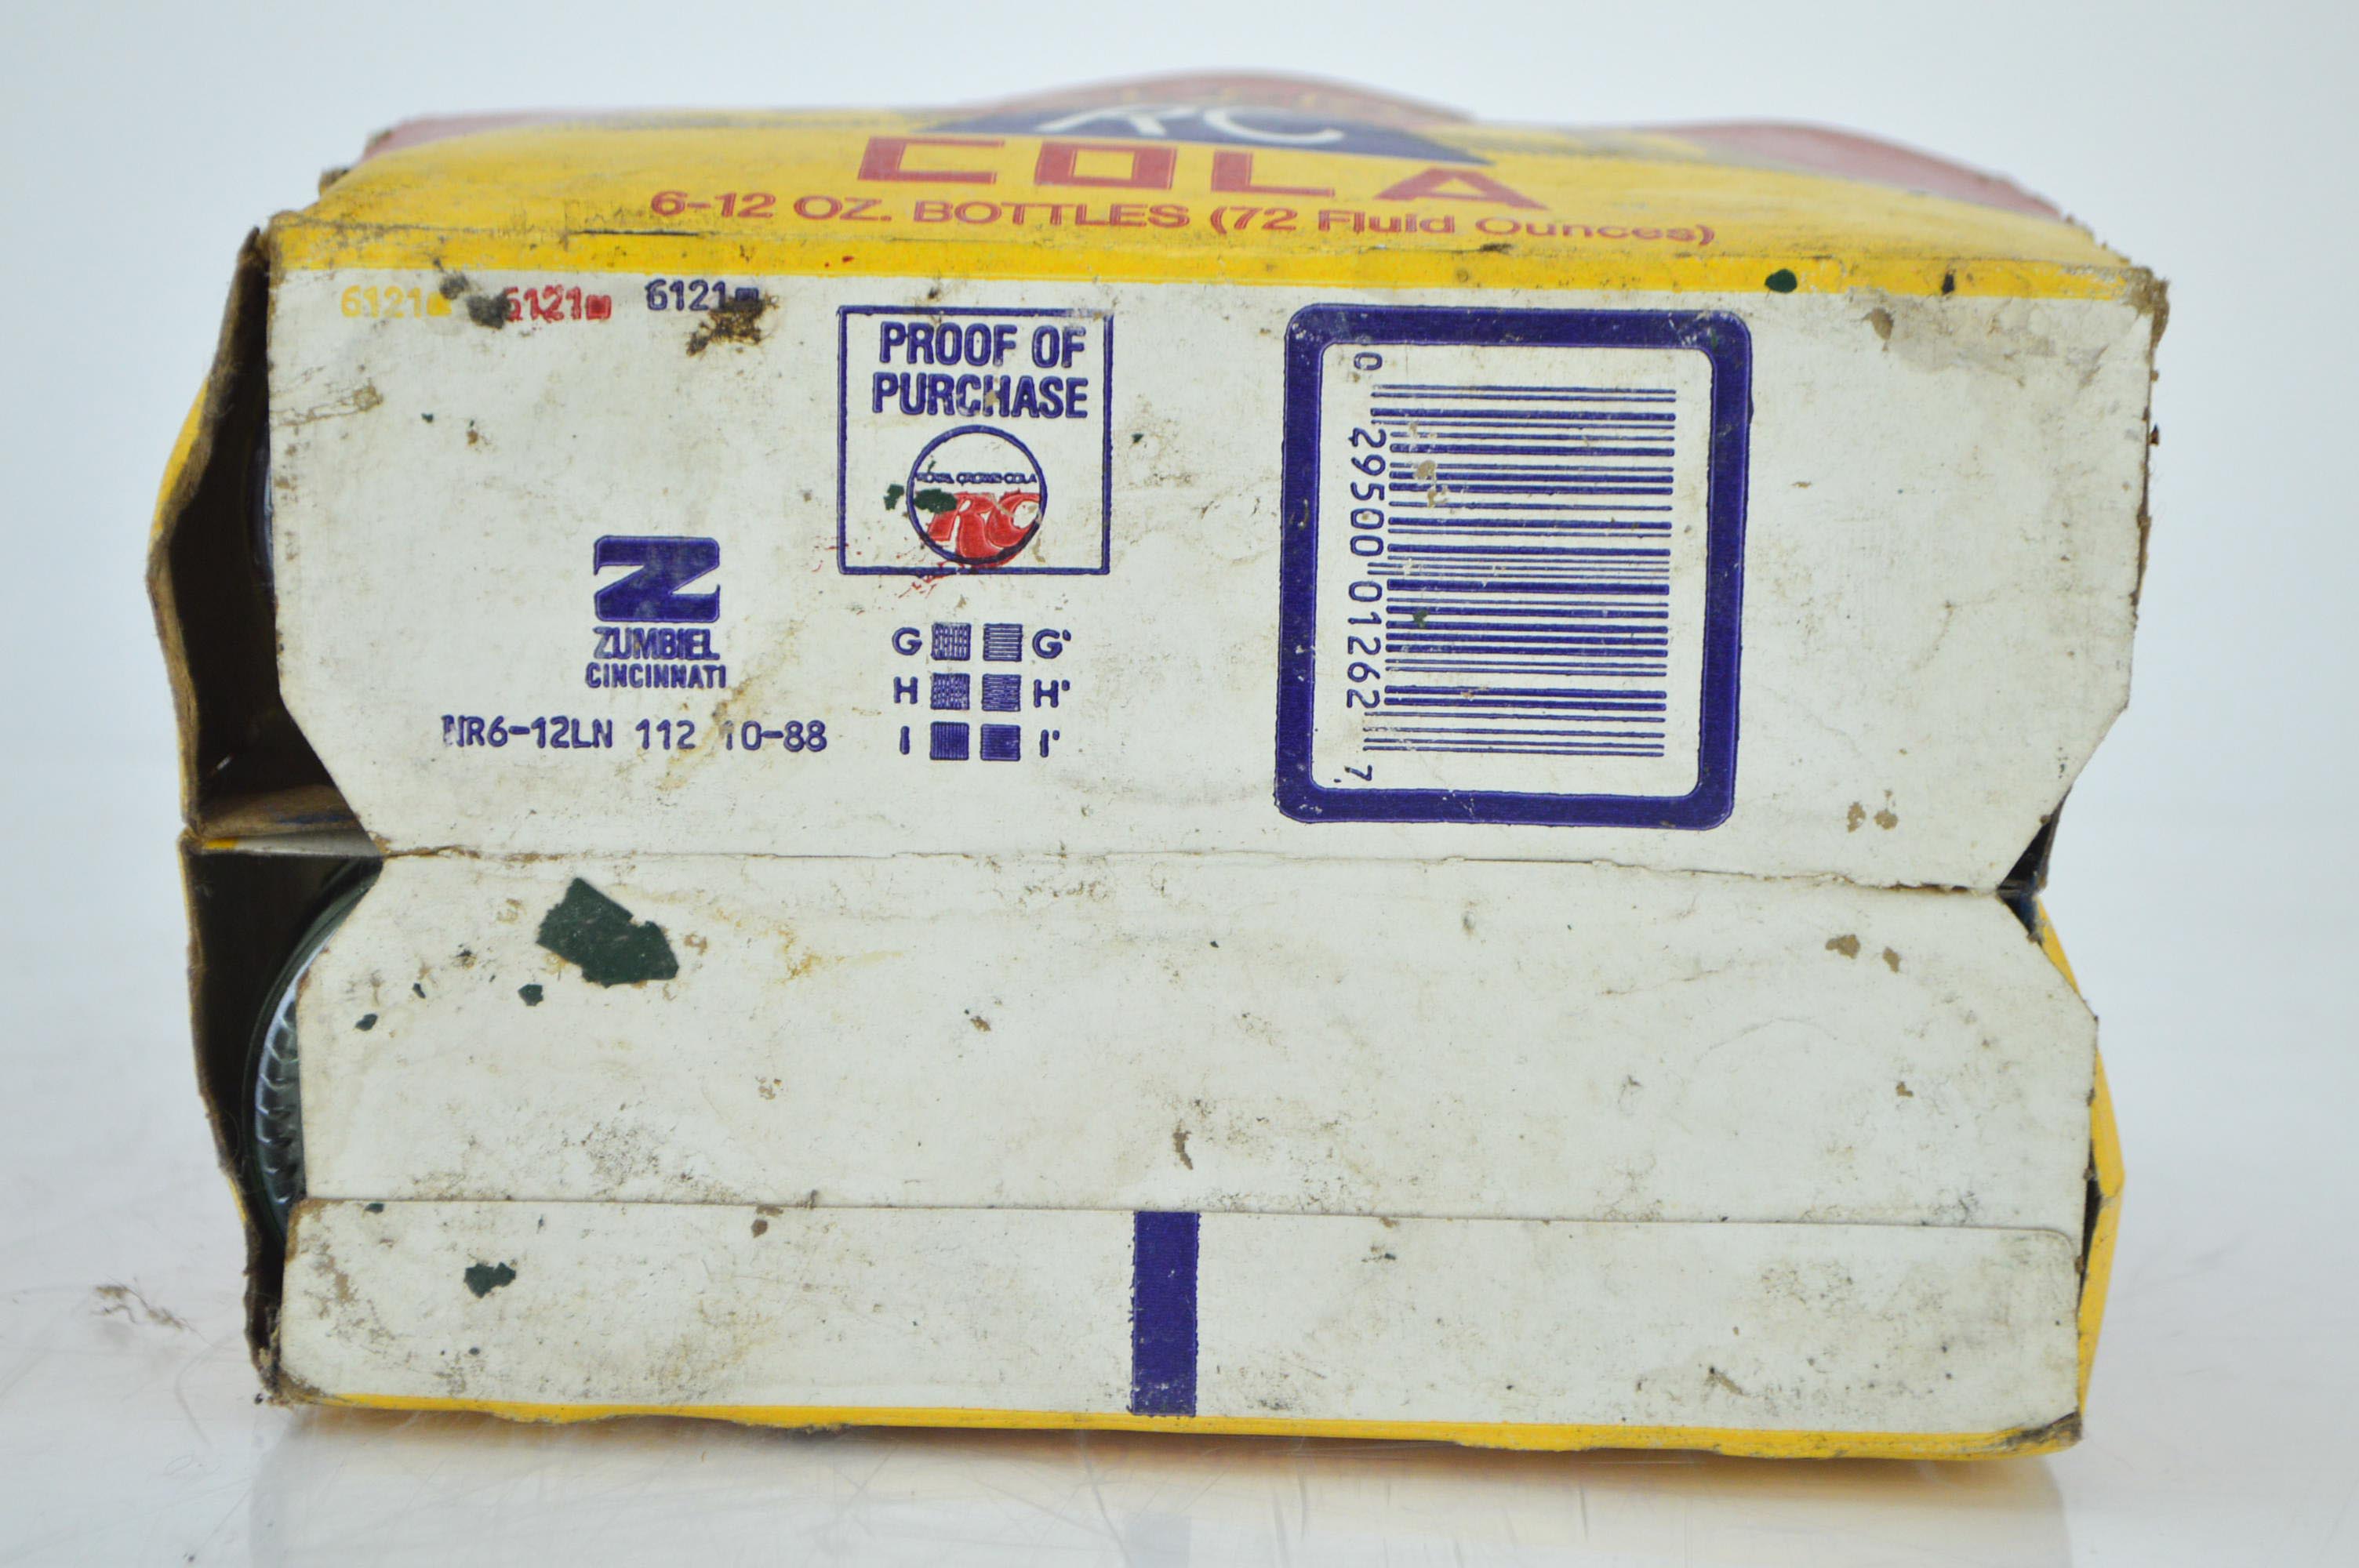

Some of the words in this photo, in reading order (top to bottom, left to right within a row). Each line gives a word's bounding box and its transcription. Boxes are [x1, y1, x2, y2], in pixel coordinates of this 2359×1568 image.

[858, 136, 1549, 209] COLA
[650, 191, 776, 219] 6-12
[793, 195, 892, 222] OZ.
[913, 200, 1190, 228] BOTTLES
[1211, 205, 1297, 235] (72
[1318, 209, 1456, 234] Fluid
[1475, 216, 1715, 247] Ounces)
[340, 285, 422, 317] 6121
[645, 278, 726, 311] 6121
[879, 321, 1017, 366] PROOF
[1032, 325, 1087, 368] OF
[872, 372, 1089, 419] PURCHASE
[1347, 426, 1387, 557] 29500
[593, 626, 720, 661] ZUMBIEL
[892, 627, 922, 655] G
[1346, 580, 1383, 710] 01262
[586, 662, 726, 689] CINCINNATI
[893, 676, 918, 704] H
[635, 718, 696, 750] 112
[722, 720, 828, 753] 10-88
[1344, 764, 1372, 782] 7
